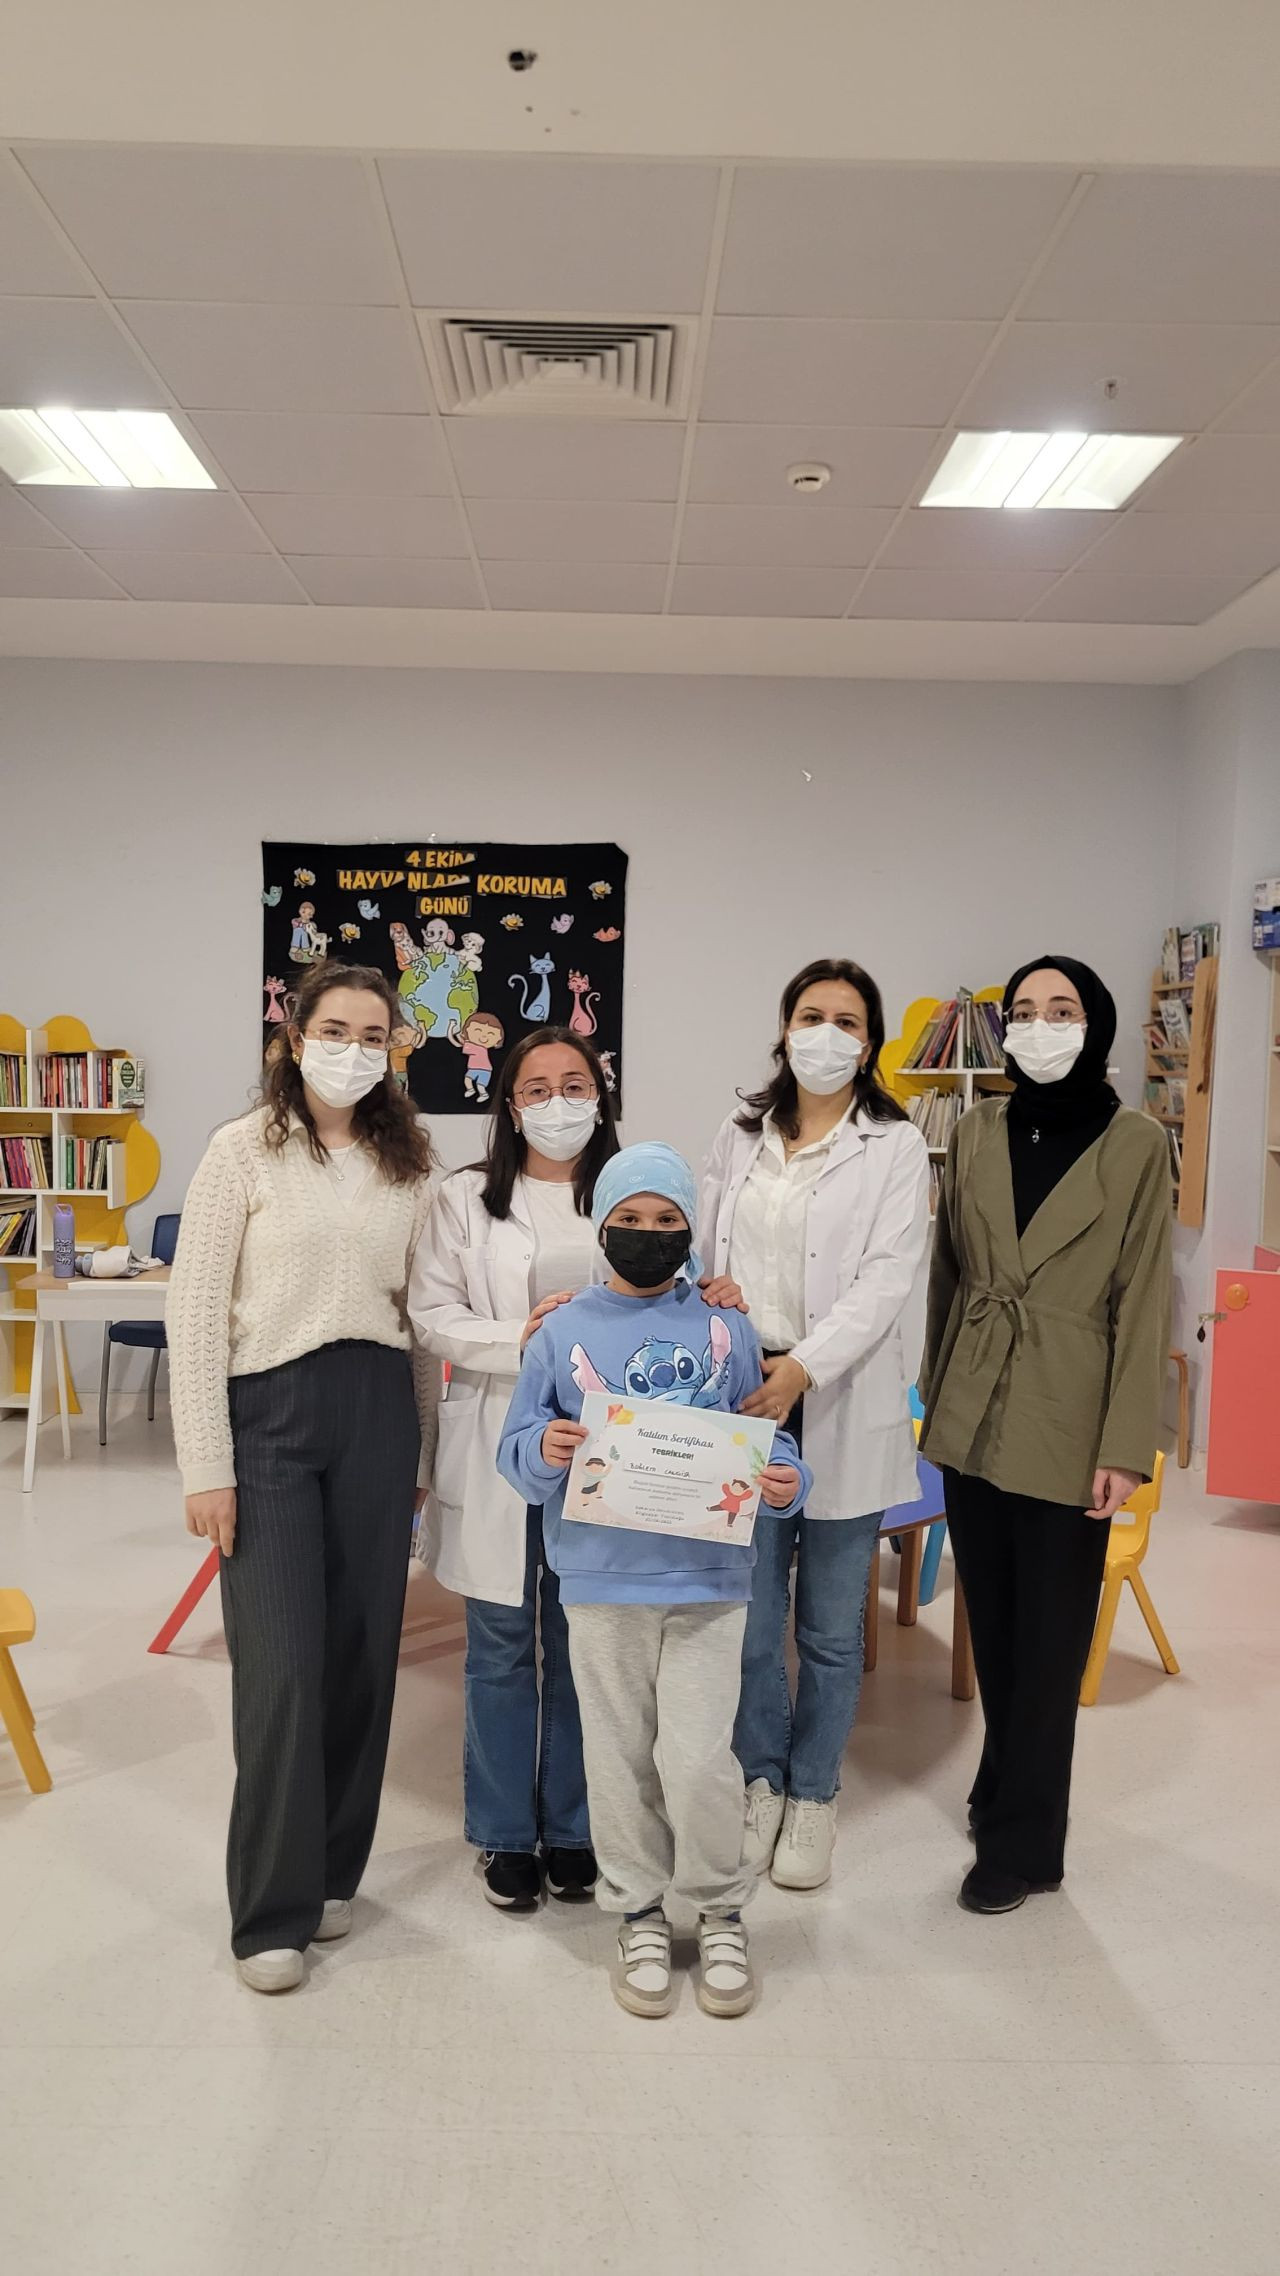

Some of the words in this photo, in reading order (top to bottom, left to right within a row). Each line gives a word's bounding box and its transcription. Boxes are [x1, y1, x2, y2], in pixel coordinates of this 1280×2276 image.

[406, 850, 421, 868] 4
[477, 874, 567, 896] KORUMA
[420, 897, 468, 915] GÜNÜ
